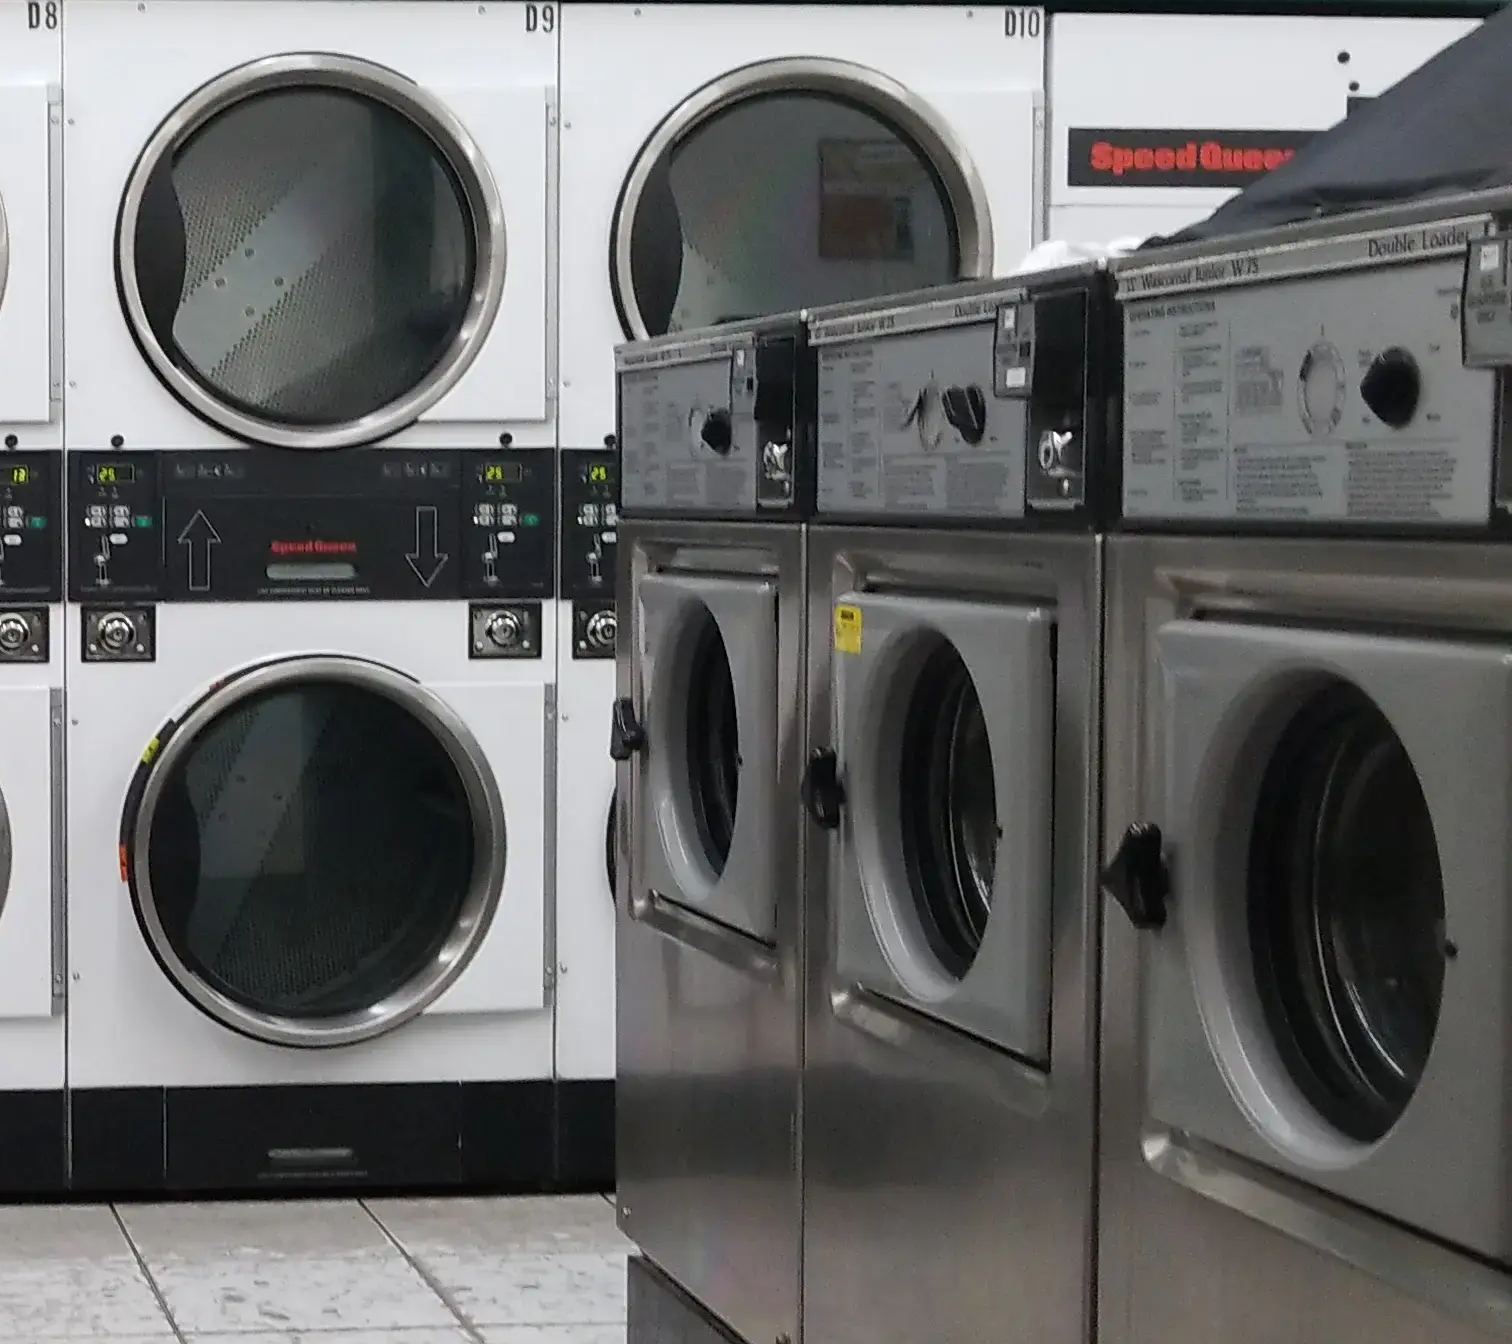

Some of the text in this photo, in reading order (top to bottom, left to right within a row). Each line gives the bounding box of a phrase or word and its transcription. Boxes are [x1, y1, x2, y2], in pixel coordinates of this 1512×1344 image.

[28, 1, 58, 30] D8
[525, 4, 554, 33] D9
[1004, 8, 1040, 38] D10
[1368, 235, 1416, 258] Double
